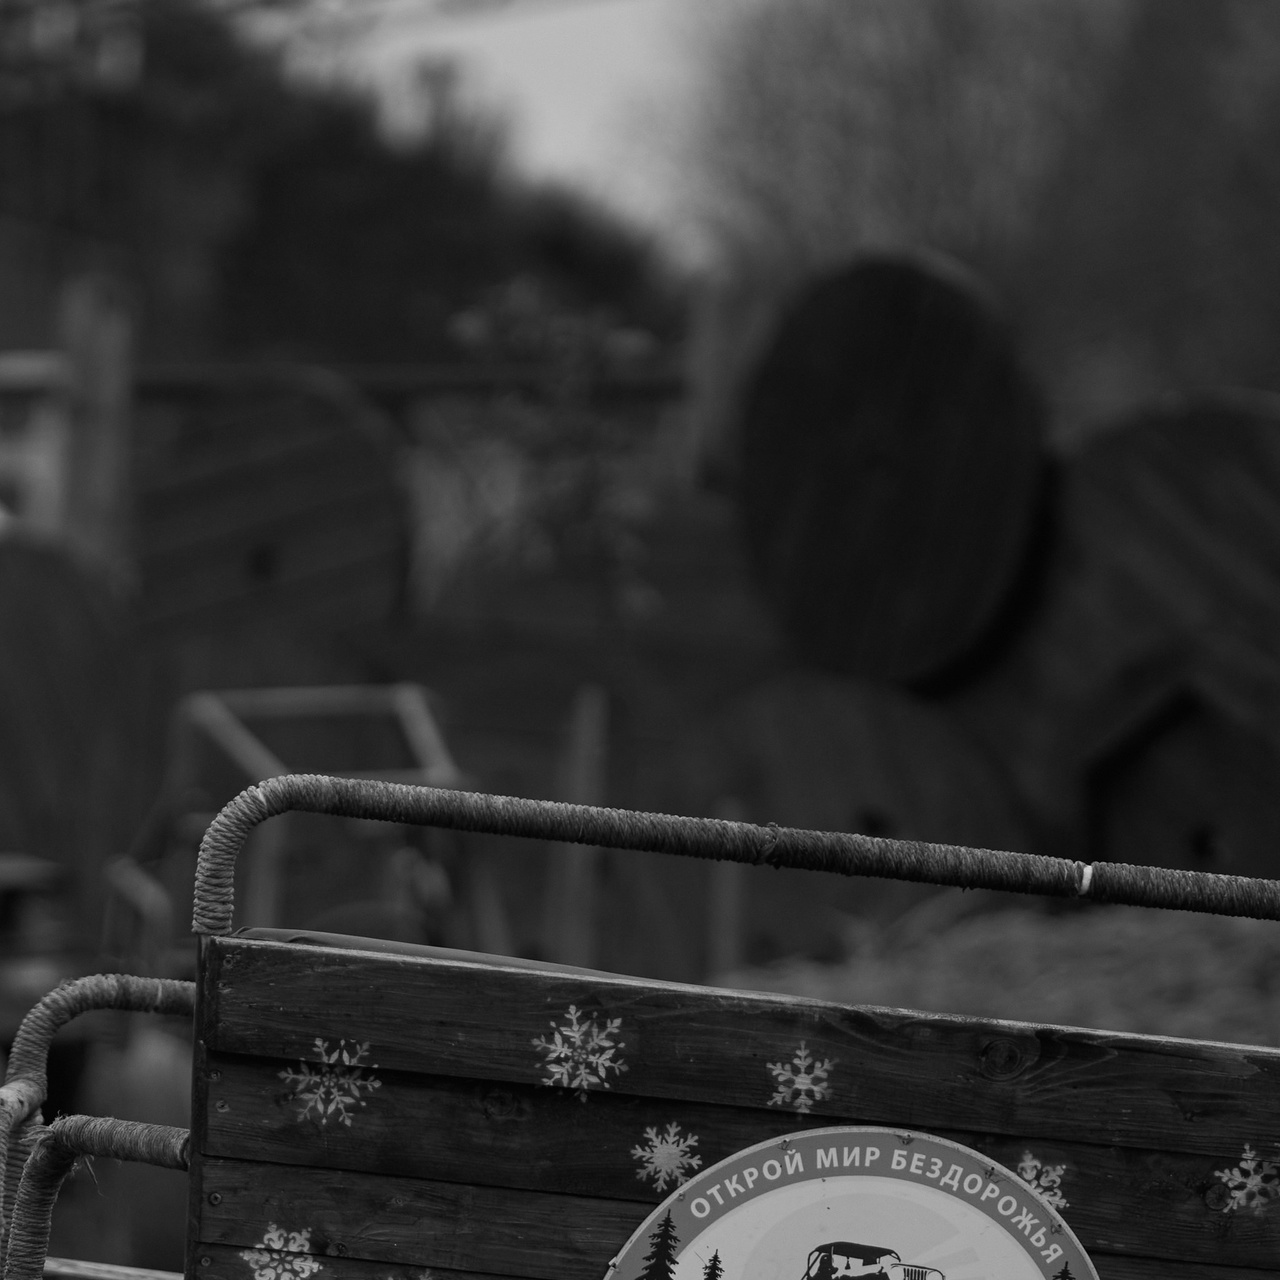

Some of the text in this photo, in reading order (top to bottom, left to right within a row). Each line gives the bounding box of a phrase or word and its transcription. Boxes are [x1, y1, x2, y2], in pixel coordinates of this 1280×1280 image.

[690, 1146, 1064, 1264] ОТКРОЙ МИР БЕЗДОРОЖЬЯ
